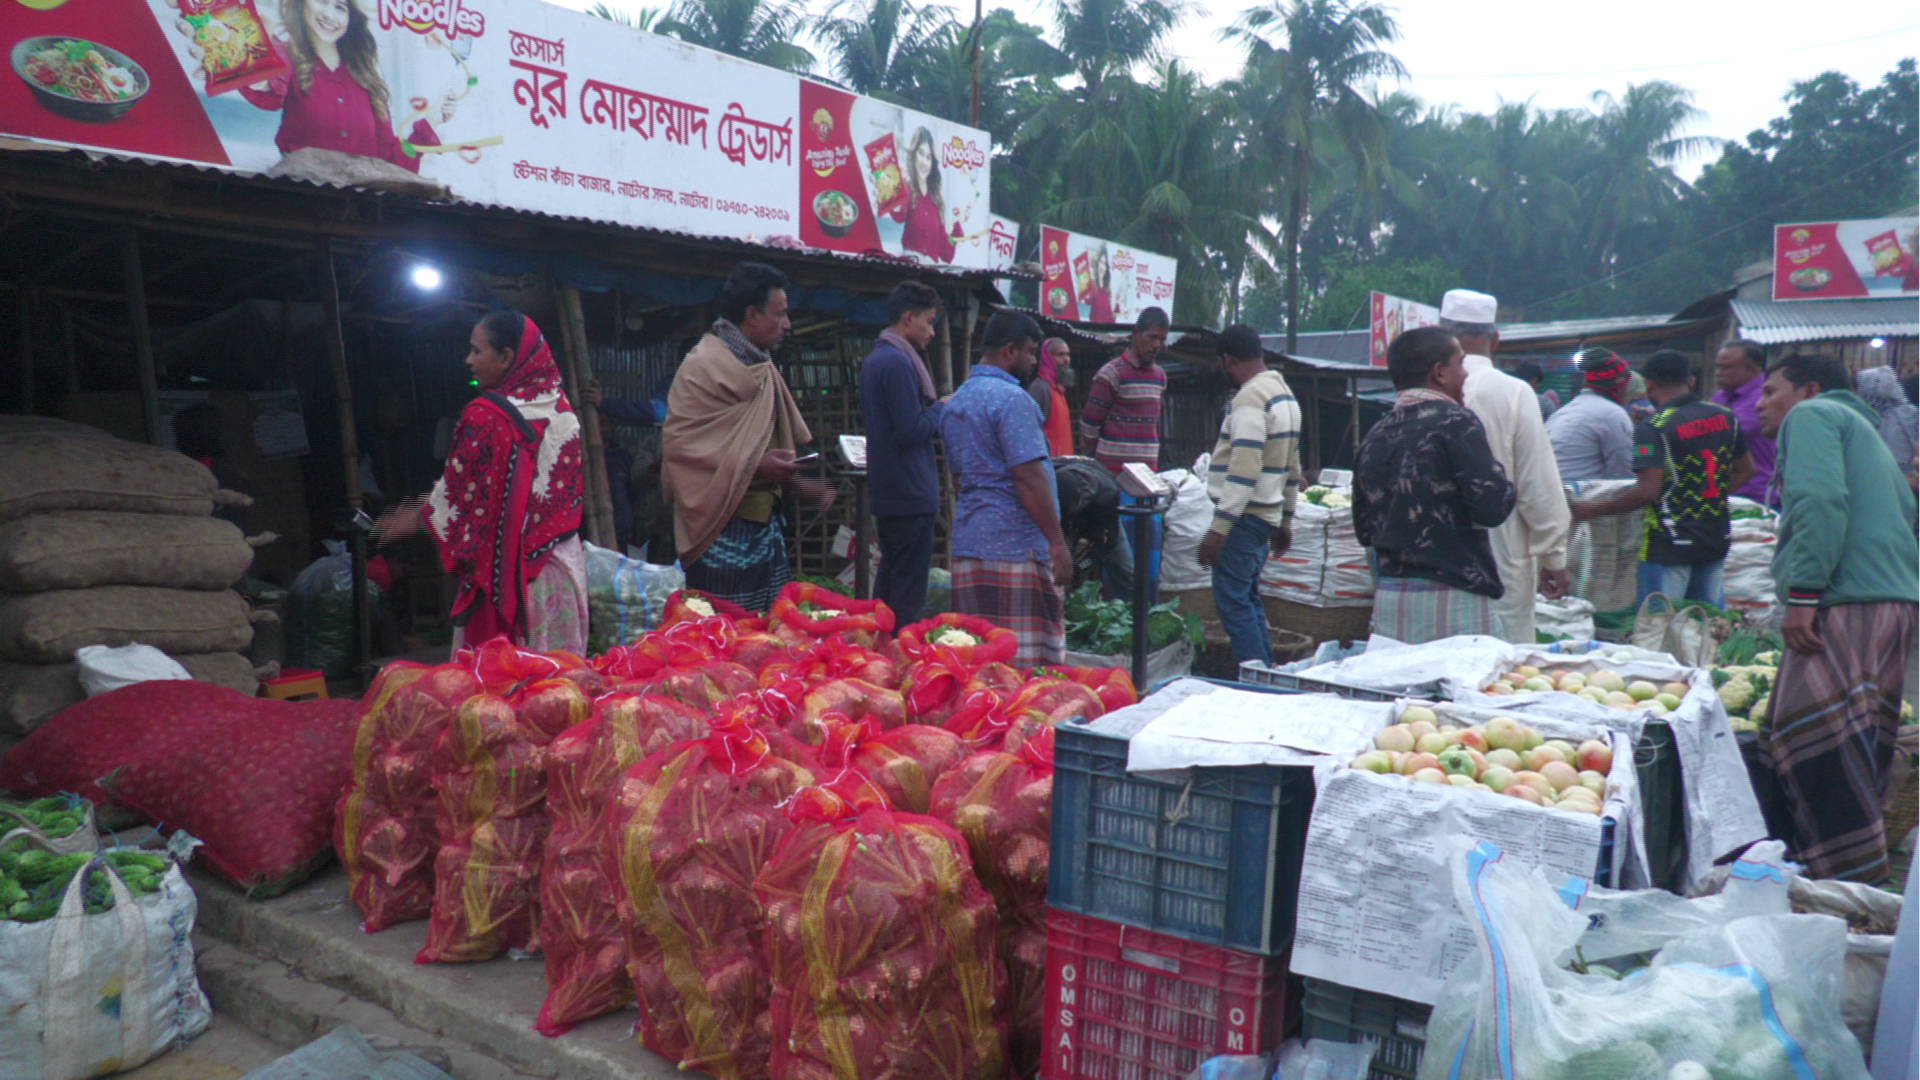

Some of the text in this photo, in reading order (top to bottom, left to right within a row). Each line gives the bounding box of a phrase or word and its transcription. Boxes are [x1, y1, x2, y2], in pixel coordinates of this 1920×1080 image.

[378, 0, 484, 40] Noodles
[508, 29, 565, 67] মেসার্স
[509, 58, 793, 167] নূর মোহাম্মাদ ট্রেডার্স
[550, 164, 575, 188] কাঁচা
[576, 173, 615, 196] বাজার,
[617, 179, 650, 200] নাটোর
[651, 187, 677, 207] সদর,
[1699, 448, 1720, 498] 1
